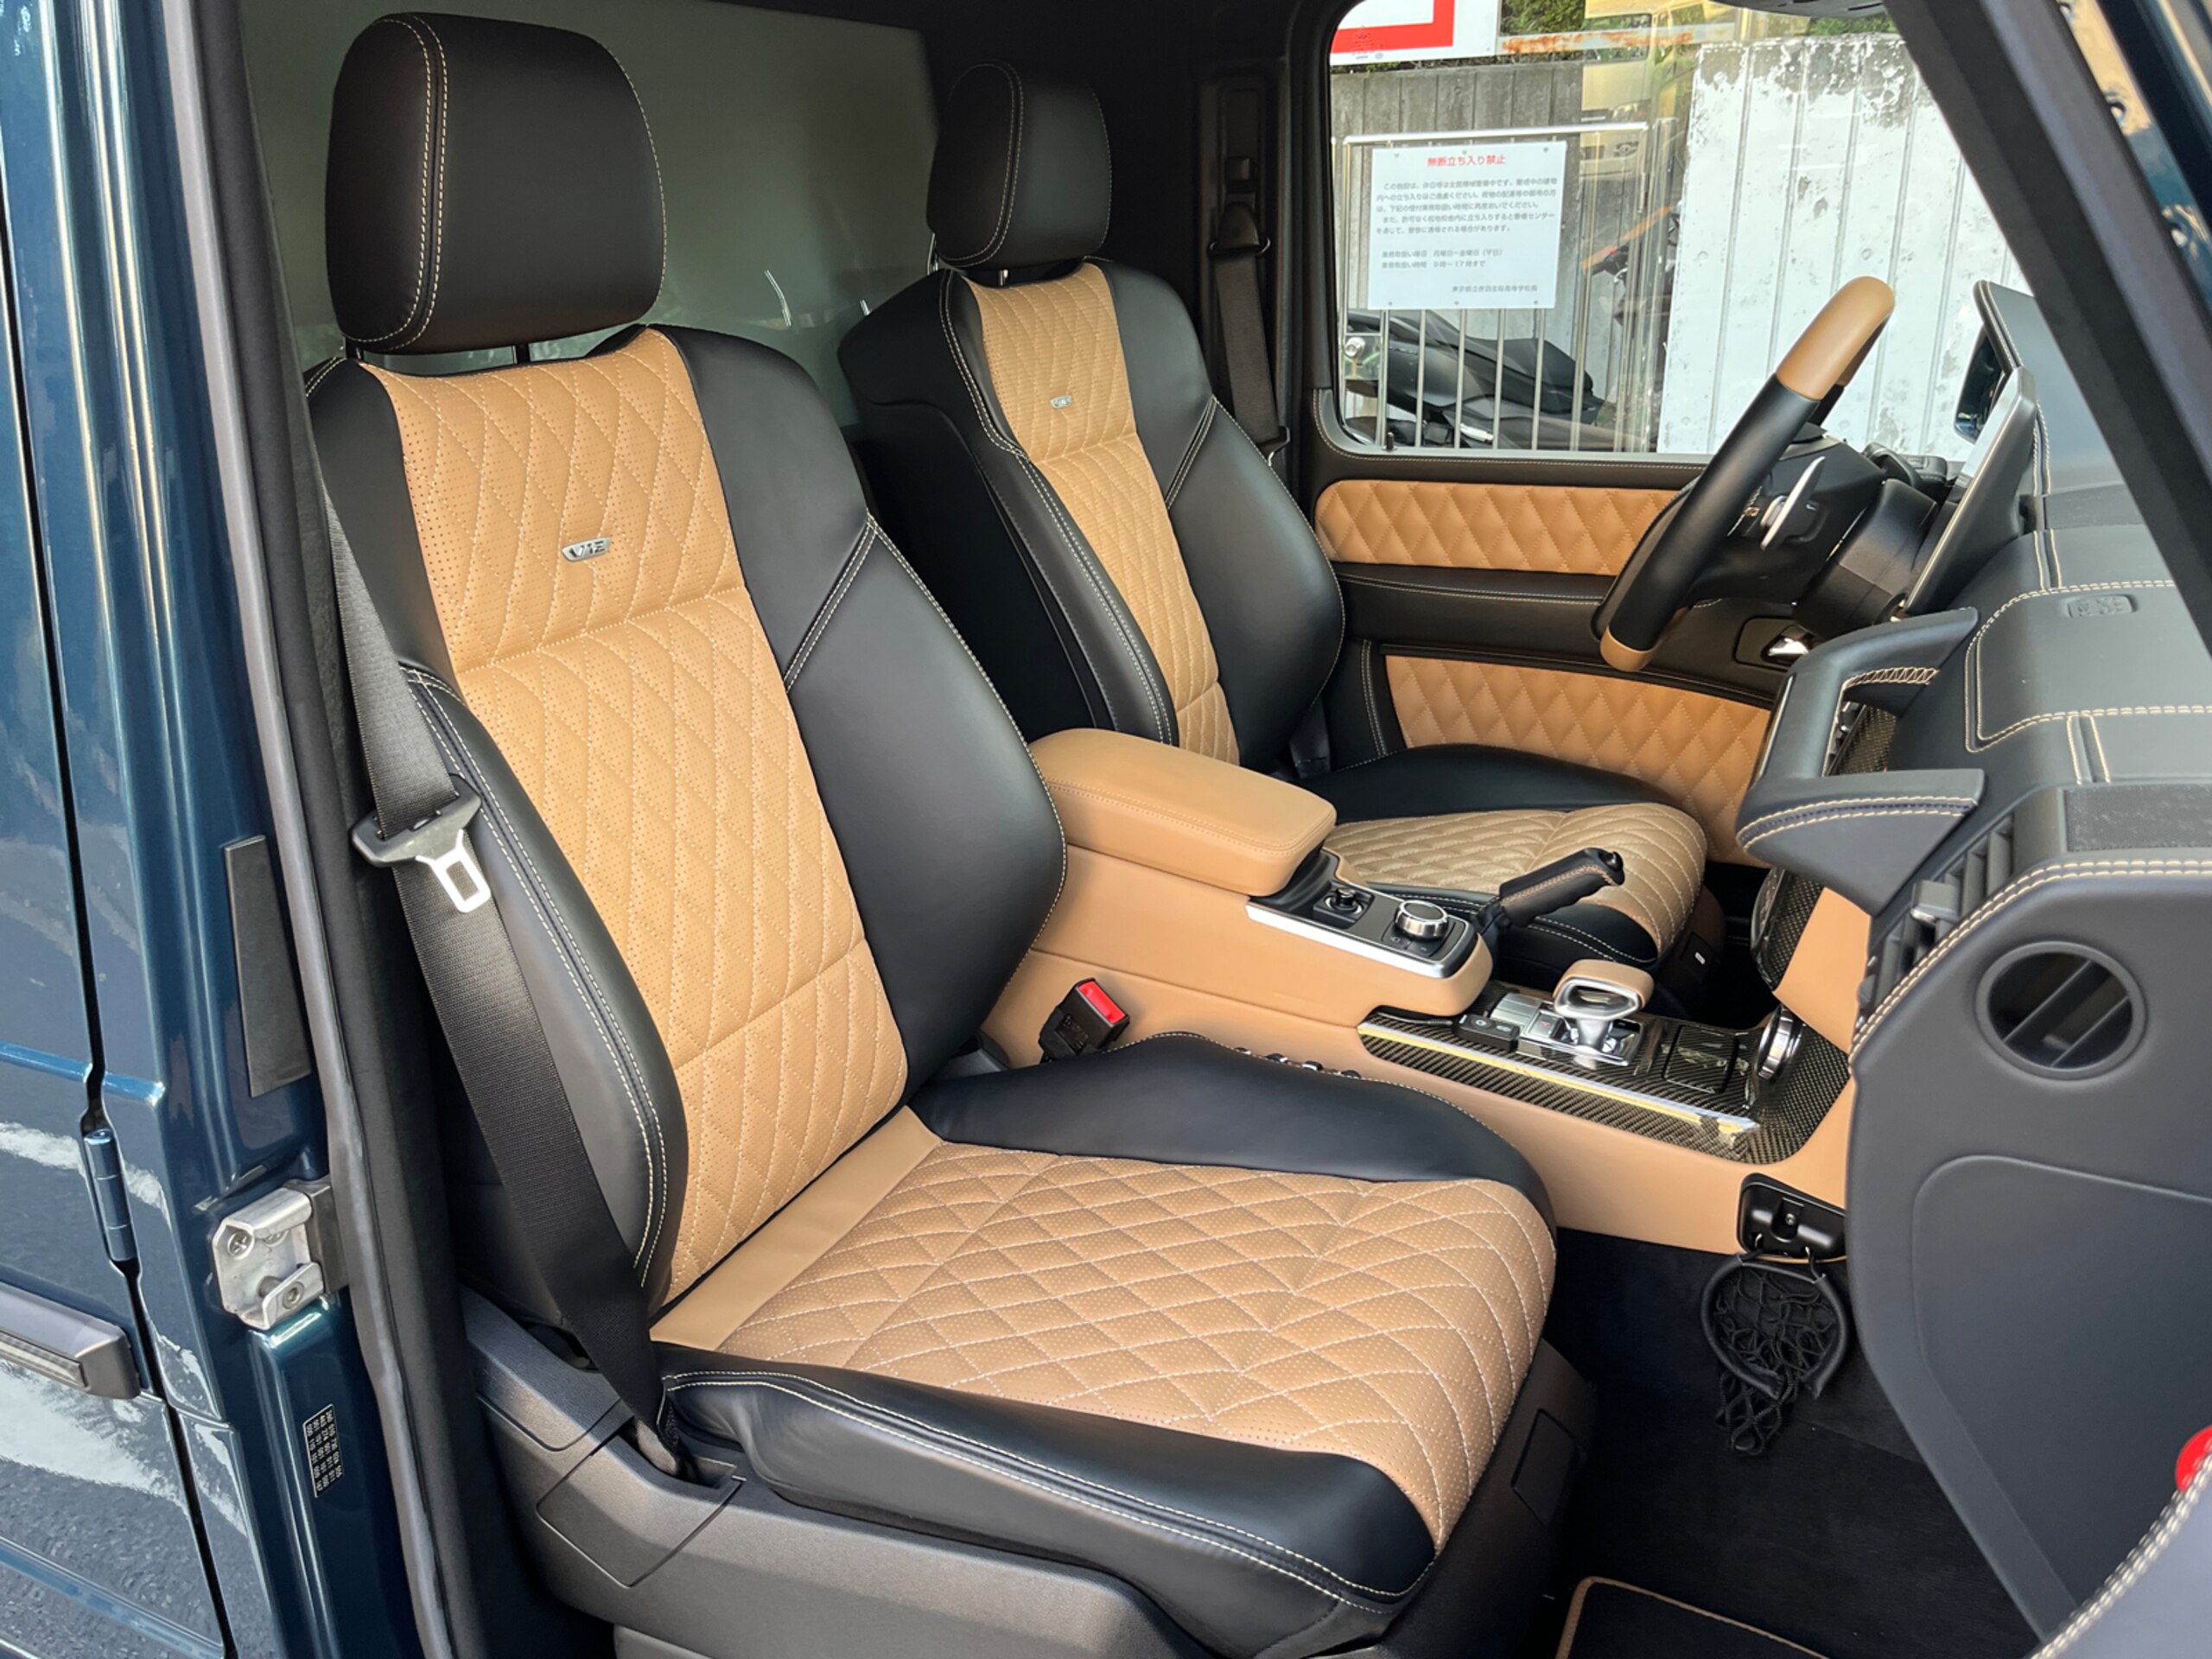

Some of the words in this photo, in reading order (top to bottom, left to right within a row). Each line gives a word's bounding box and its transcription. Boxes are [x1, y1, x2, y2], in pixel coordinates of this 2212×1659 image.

[1427, 155, 1506, 167] 無断立ち入り禁止
[567, 539, 607, 559] V12
